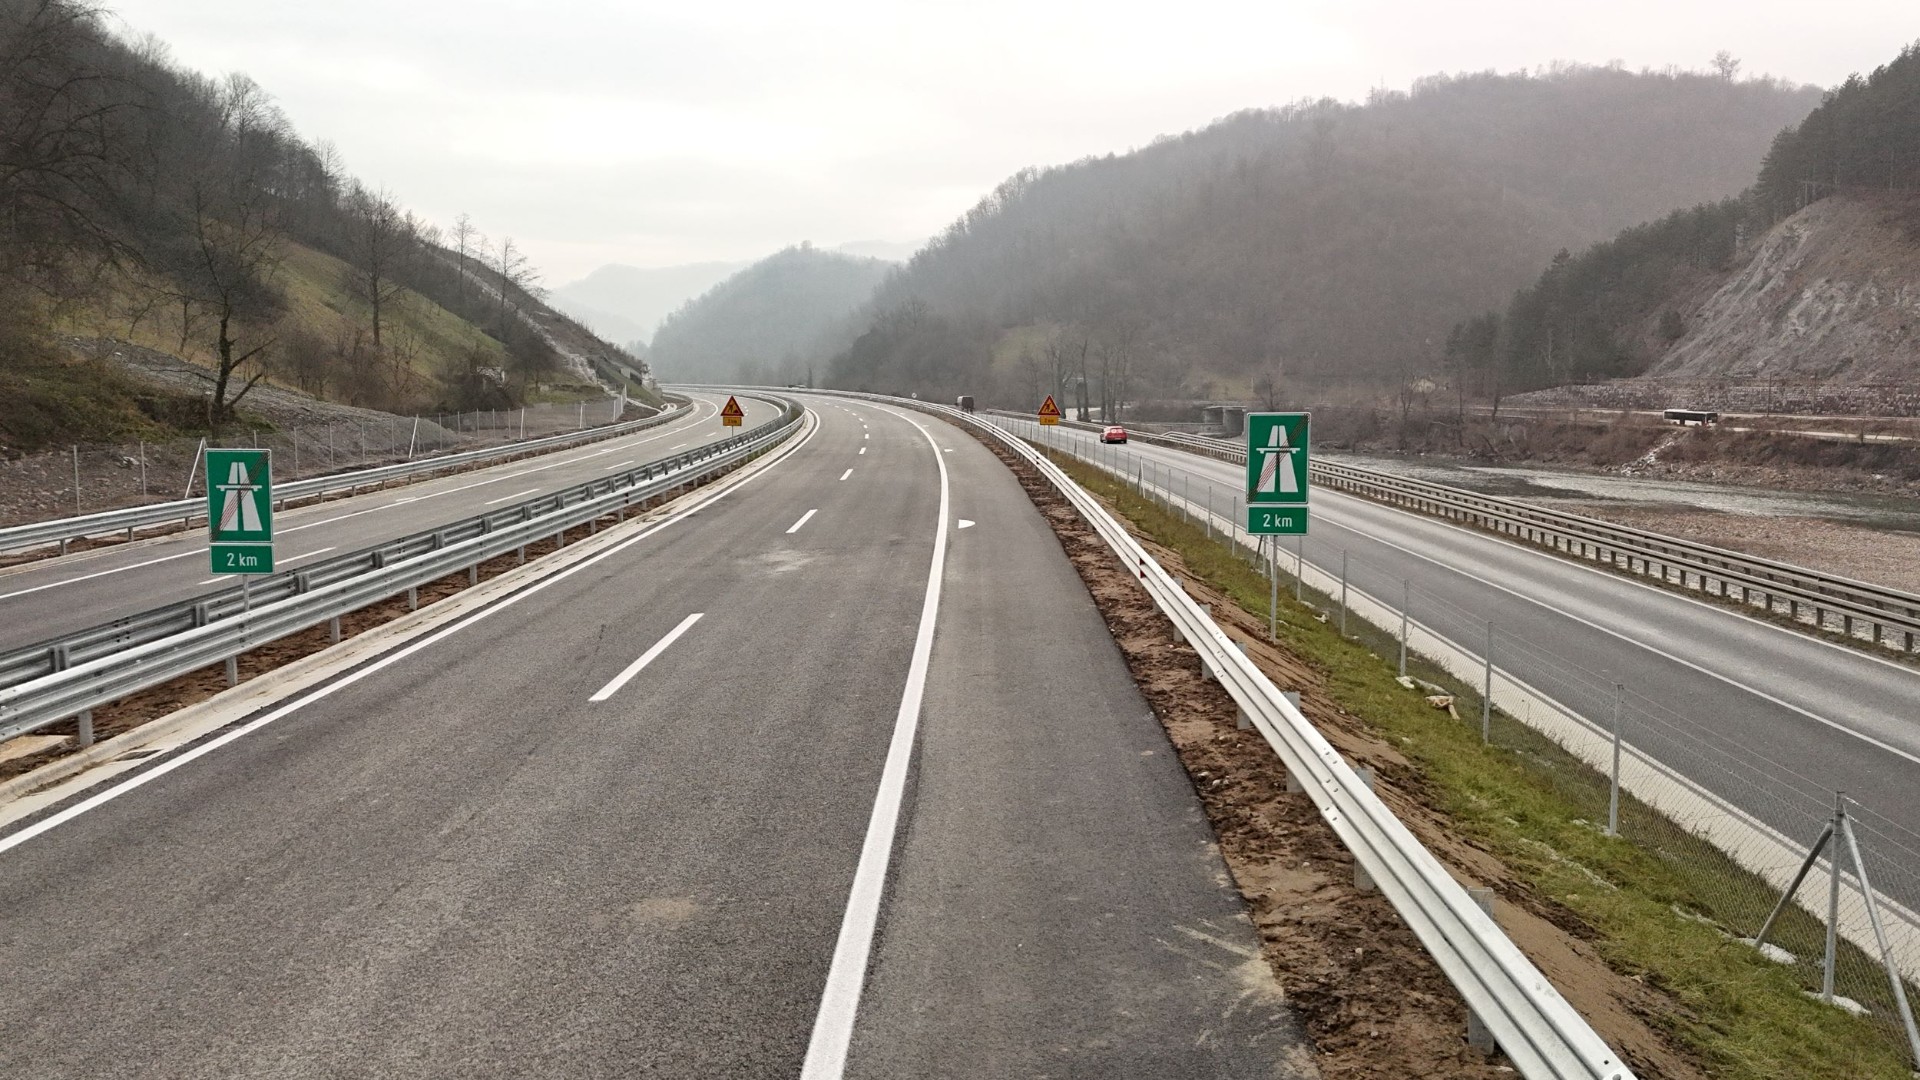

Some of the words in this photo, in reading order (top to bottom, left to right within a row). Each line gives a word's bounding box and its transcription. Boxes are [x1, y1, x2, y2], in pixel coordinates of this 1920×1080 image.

[1263, 513, 1271, 527] 2
[1274, 513, 1293, 527] km
[226, 552, 235, 567] 2
[239, 552, 258, 567] km
